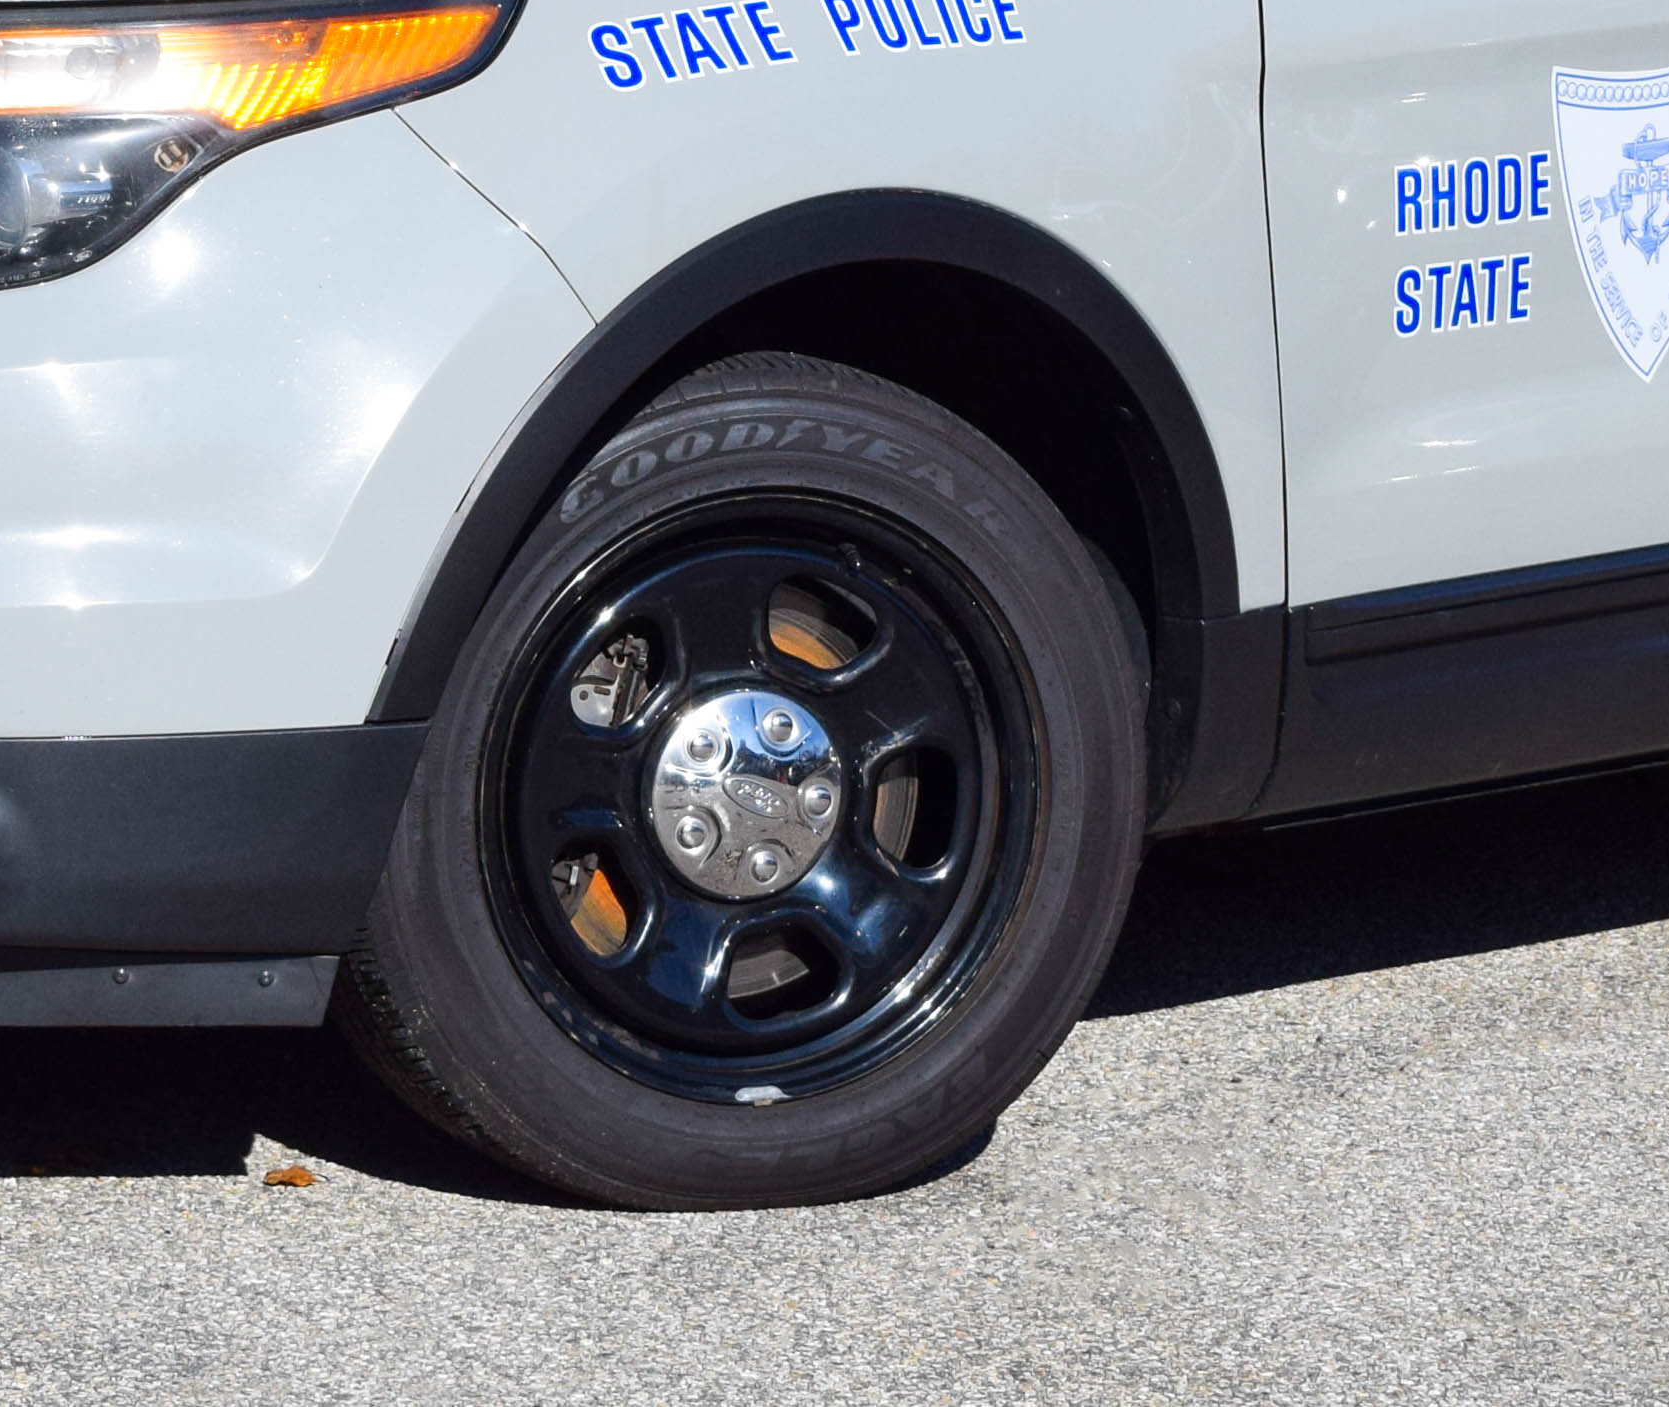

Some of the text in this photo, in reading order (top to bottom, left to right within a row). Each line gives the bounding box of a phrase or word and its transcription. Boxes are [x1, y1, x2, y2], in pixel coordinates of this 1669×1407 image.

[589, 0, 796, 90] STATE
[1394, 152, 1551, 236] RHODE
[1628, 170, 1669, 190] HOPE
[1394, 254, 1531, 336] STATE
[559, 420, 1014, 540] GOODYEAR
